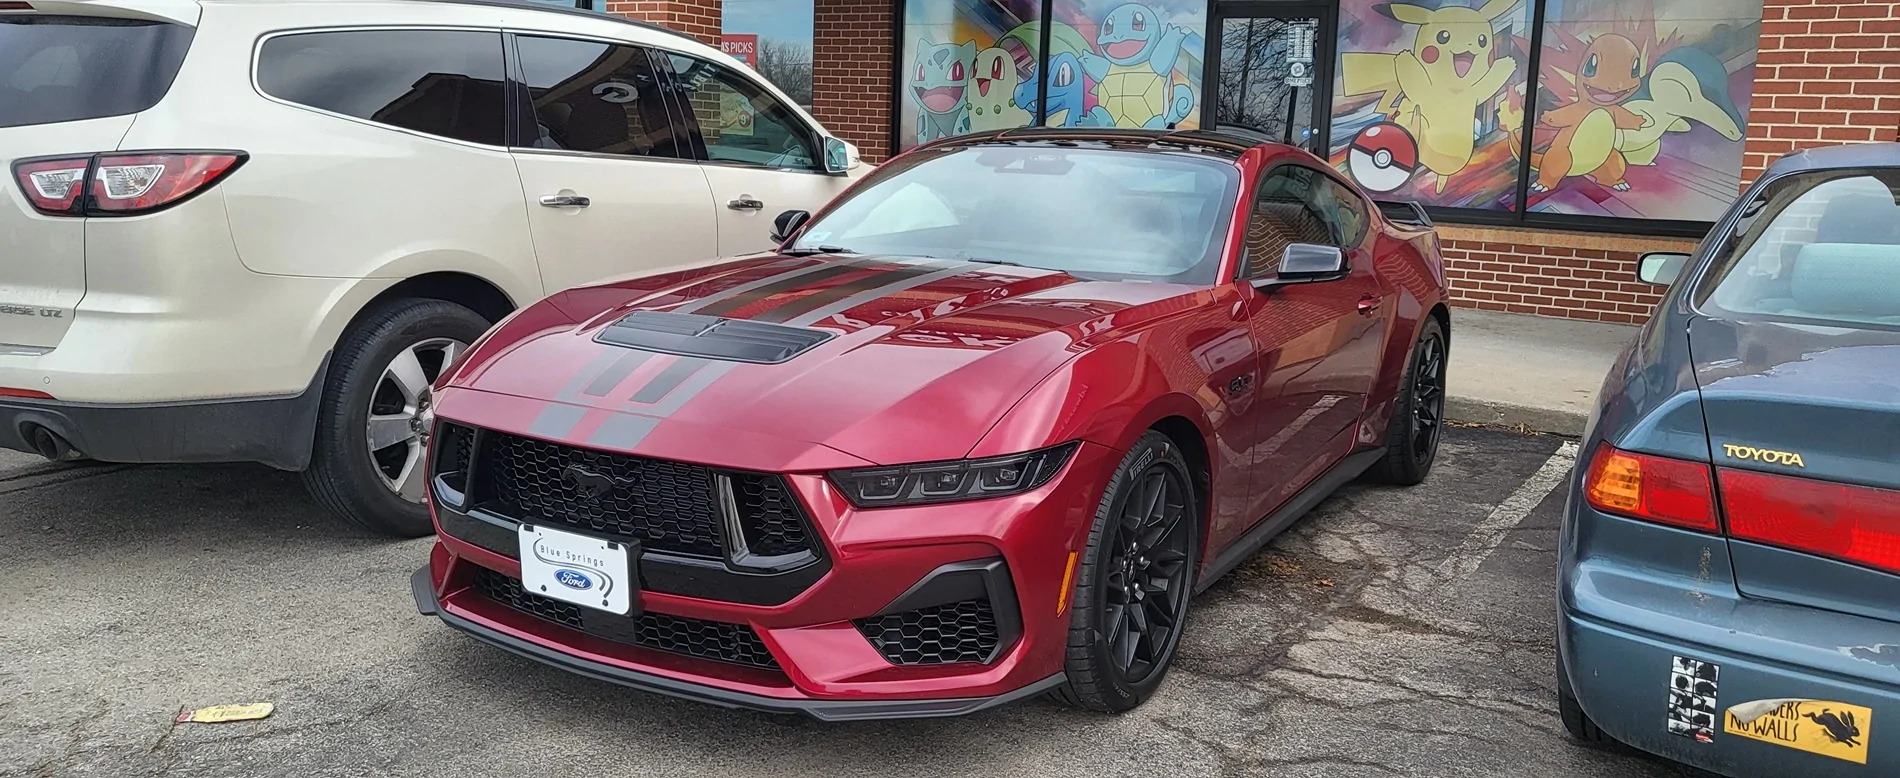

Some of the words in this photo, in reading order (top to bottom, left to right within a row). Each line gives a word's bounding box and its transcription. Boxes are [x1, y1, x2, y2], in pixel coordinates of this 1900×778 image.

[730, 42, 754, 54] PICKS
[39, 307, 63, 318] LTZ
[1128, 446, 1154, 482] PIRELLI
[1723, 443, 1805, 468] TOYOTA
[540, 544, 561, 557] Blue
[565, 550, 604, 568] Springs
[560, 570, 586, 589] Ford
[1766, 701, 1802, 721] DERS
[1753, 716, 1800, 743] WALLS
